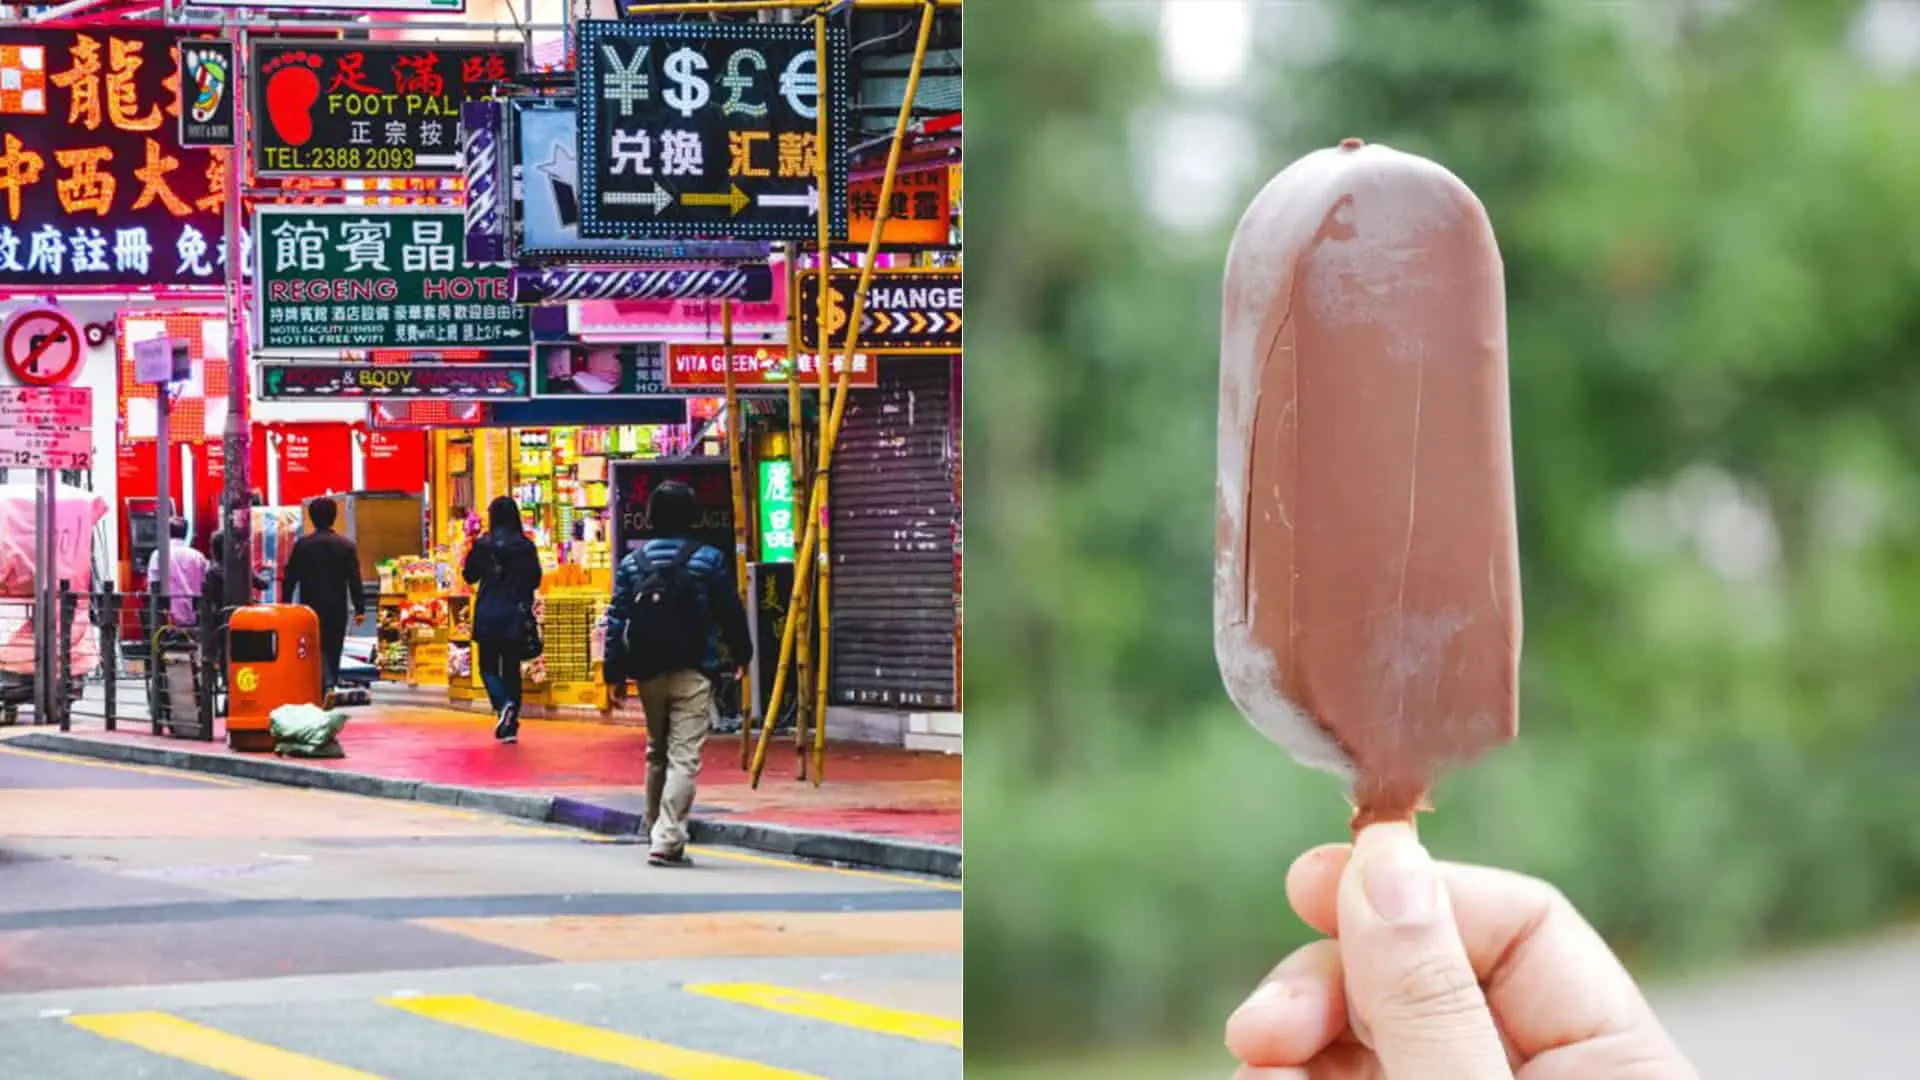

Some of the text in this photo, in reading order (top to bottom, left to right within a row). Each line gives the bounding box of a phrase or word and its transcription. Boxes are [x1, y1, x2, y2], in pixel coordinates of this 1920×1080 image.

[50, 33, 182, 131] 龍
[602, 45, 649, 116] ¥
[662, 47, 710, 117] $
[723, 48, 767, 116] £
[329, 94, 399, 115] FOOT
[350, 120, 464, 146] 正宗按
[264, 147, 414, 169] TEL:2388 2093
[610, 129, 819, 177] 兑换 汇款
[272, 219, 518, 272] 館賓晶
[269, 277, 511, 301] REGENG HOTE
[270, 335, 316, 345] HOTEL
[675, 355, 707, 373] VITA
[359, 371, 412, 386] BODY
